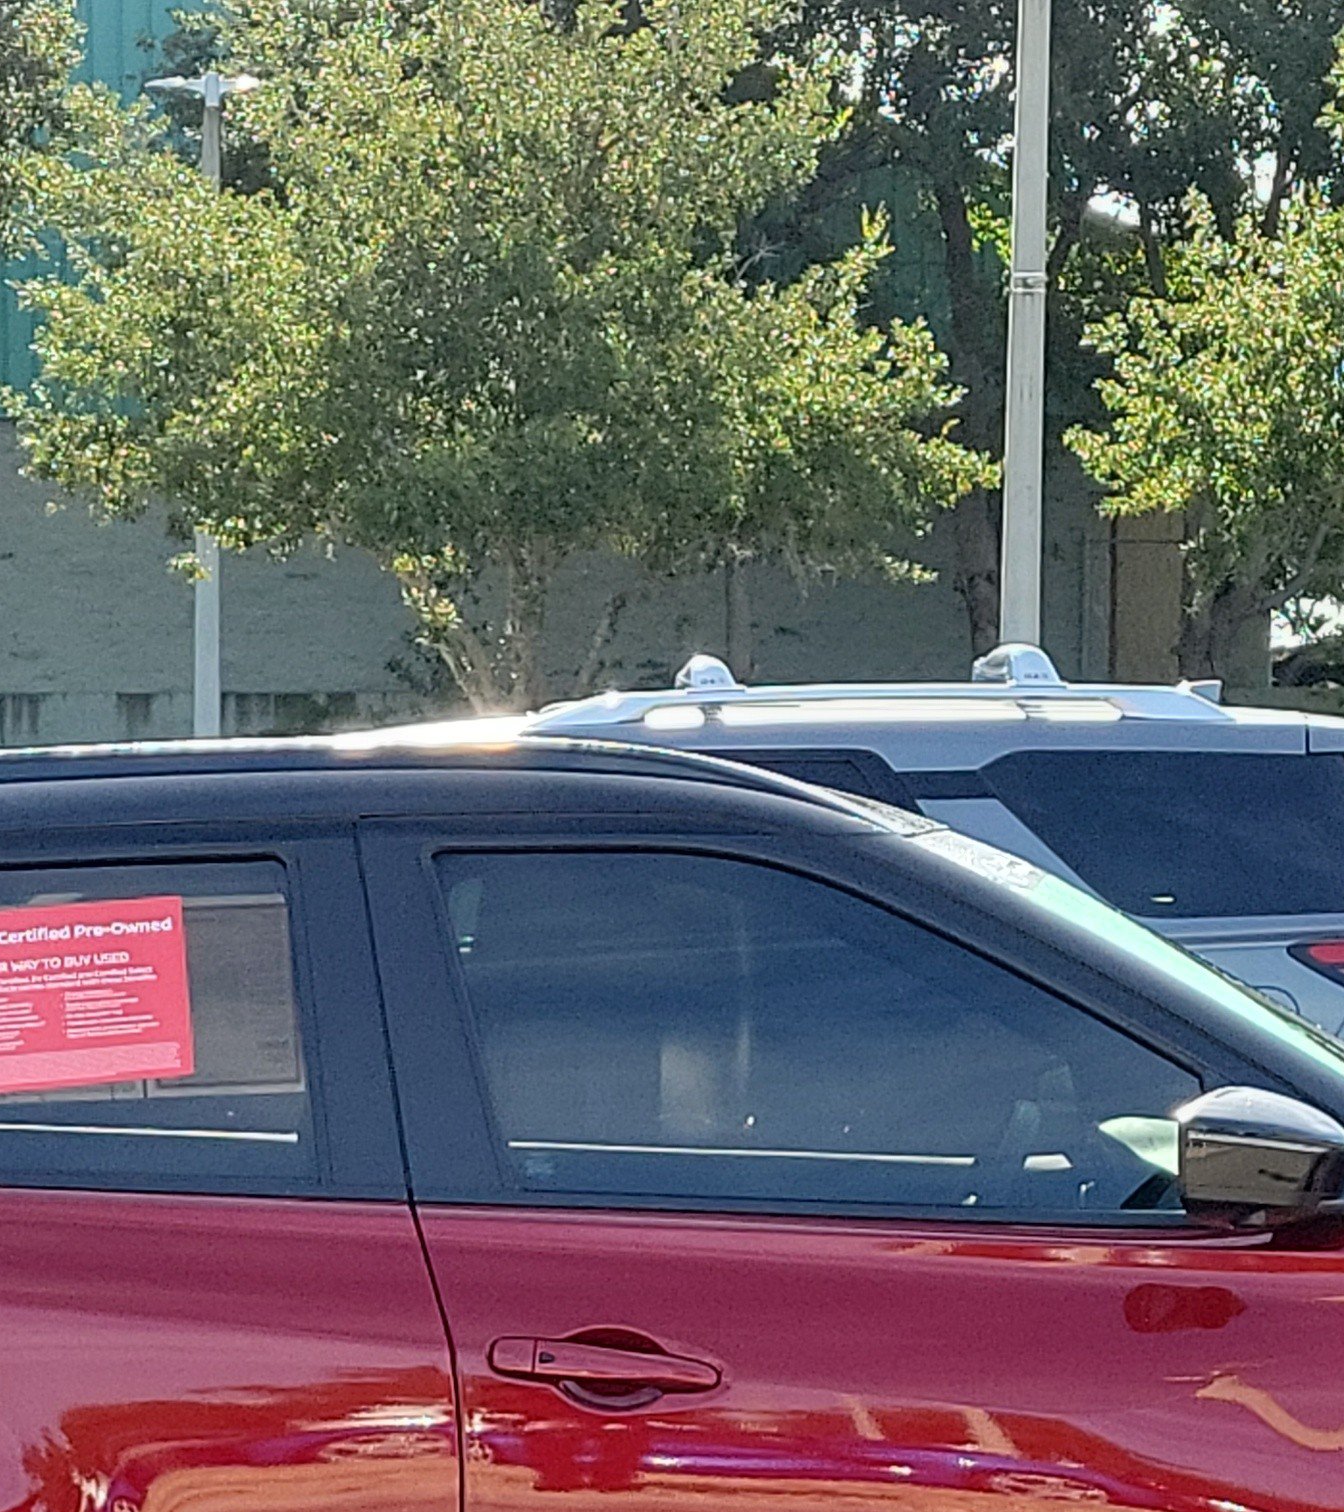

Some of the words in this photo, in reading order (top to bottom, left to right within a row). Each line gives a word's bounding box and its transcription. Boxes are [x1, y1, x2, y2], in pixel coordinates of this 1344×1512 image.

[74, 917, 172, 939] Pre-Owned
[10, 960, 41, 973] WAY
[41, 957, 61, 969] TO
[64, 953, 92, 967] BUY
[94, 952, 129, 965] USED
